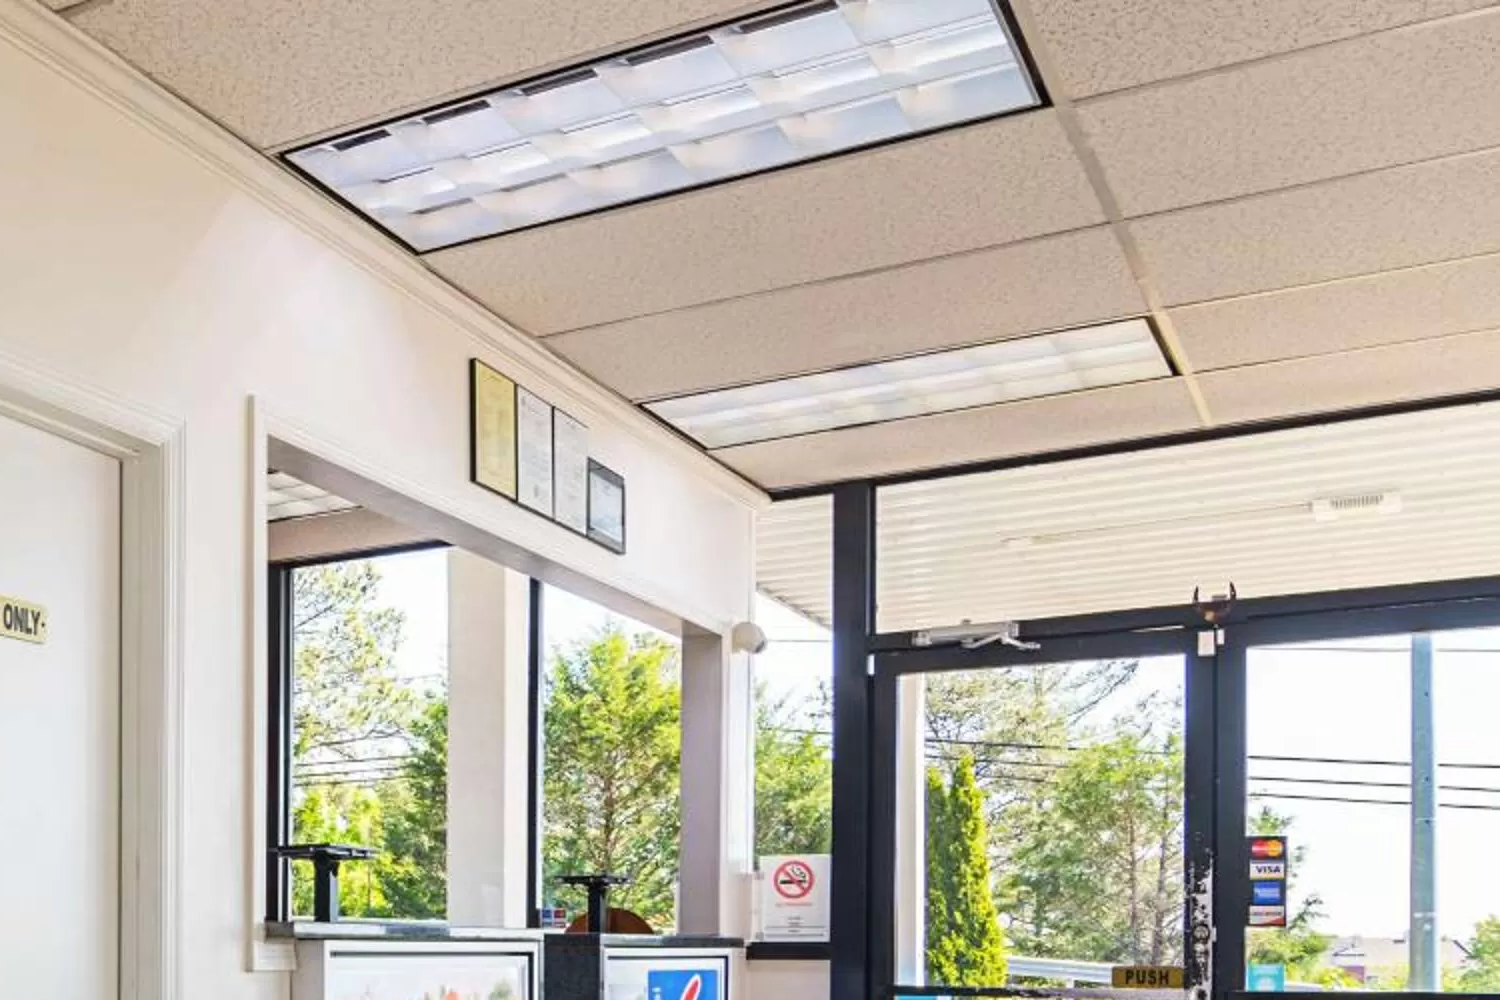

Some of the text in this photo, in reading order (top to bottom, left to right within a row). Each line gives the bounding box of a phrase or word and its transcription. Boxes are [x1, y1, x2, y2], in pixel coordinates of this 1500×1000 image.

[3, 603, 41, 636] ONLY
[1256, 865, 1280, 874] VISA
[1124, 972, 1169, 986] PUSH
